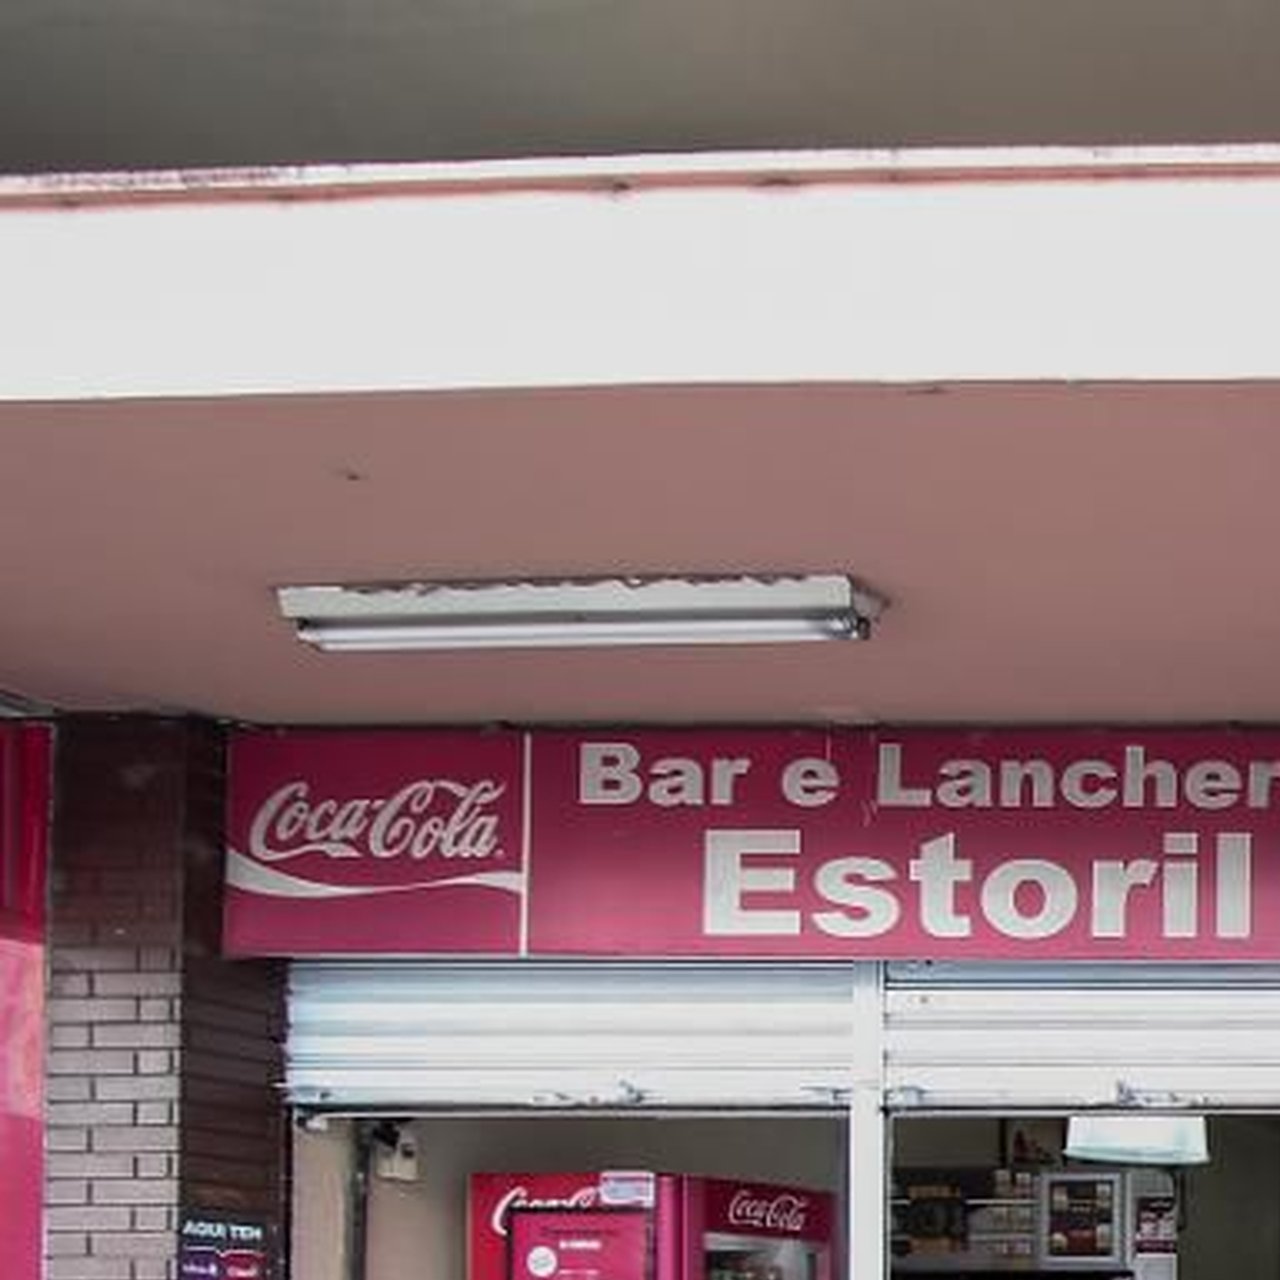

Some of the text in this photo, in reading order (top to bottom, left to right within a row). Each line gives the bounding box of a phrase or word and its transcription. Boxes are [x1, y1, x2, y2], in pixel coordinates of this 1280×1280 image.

[578, 742, 749, 806] Bar
[781, 757, 840, 806] e
[702, 828, 1253, 940] Estoril
